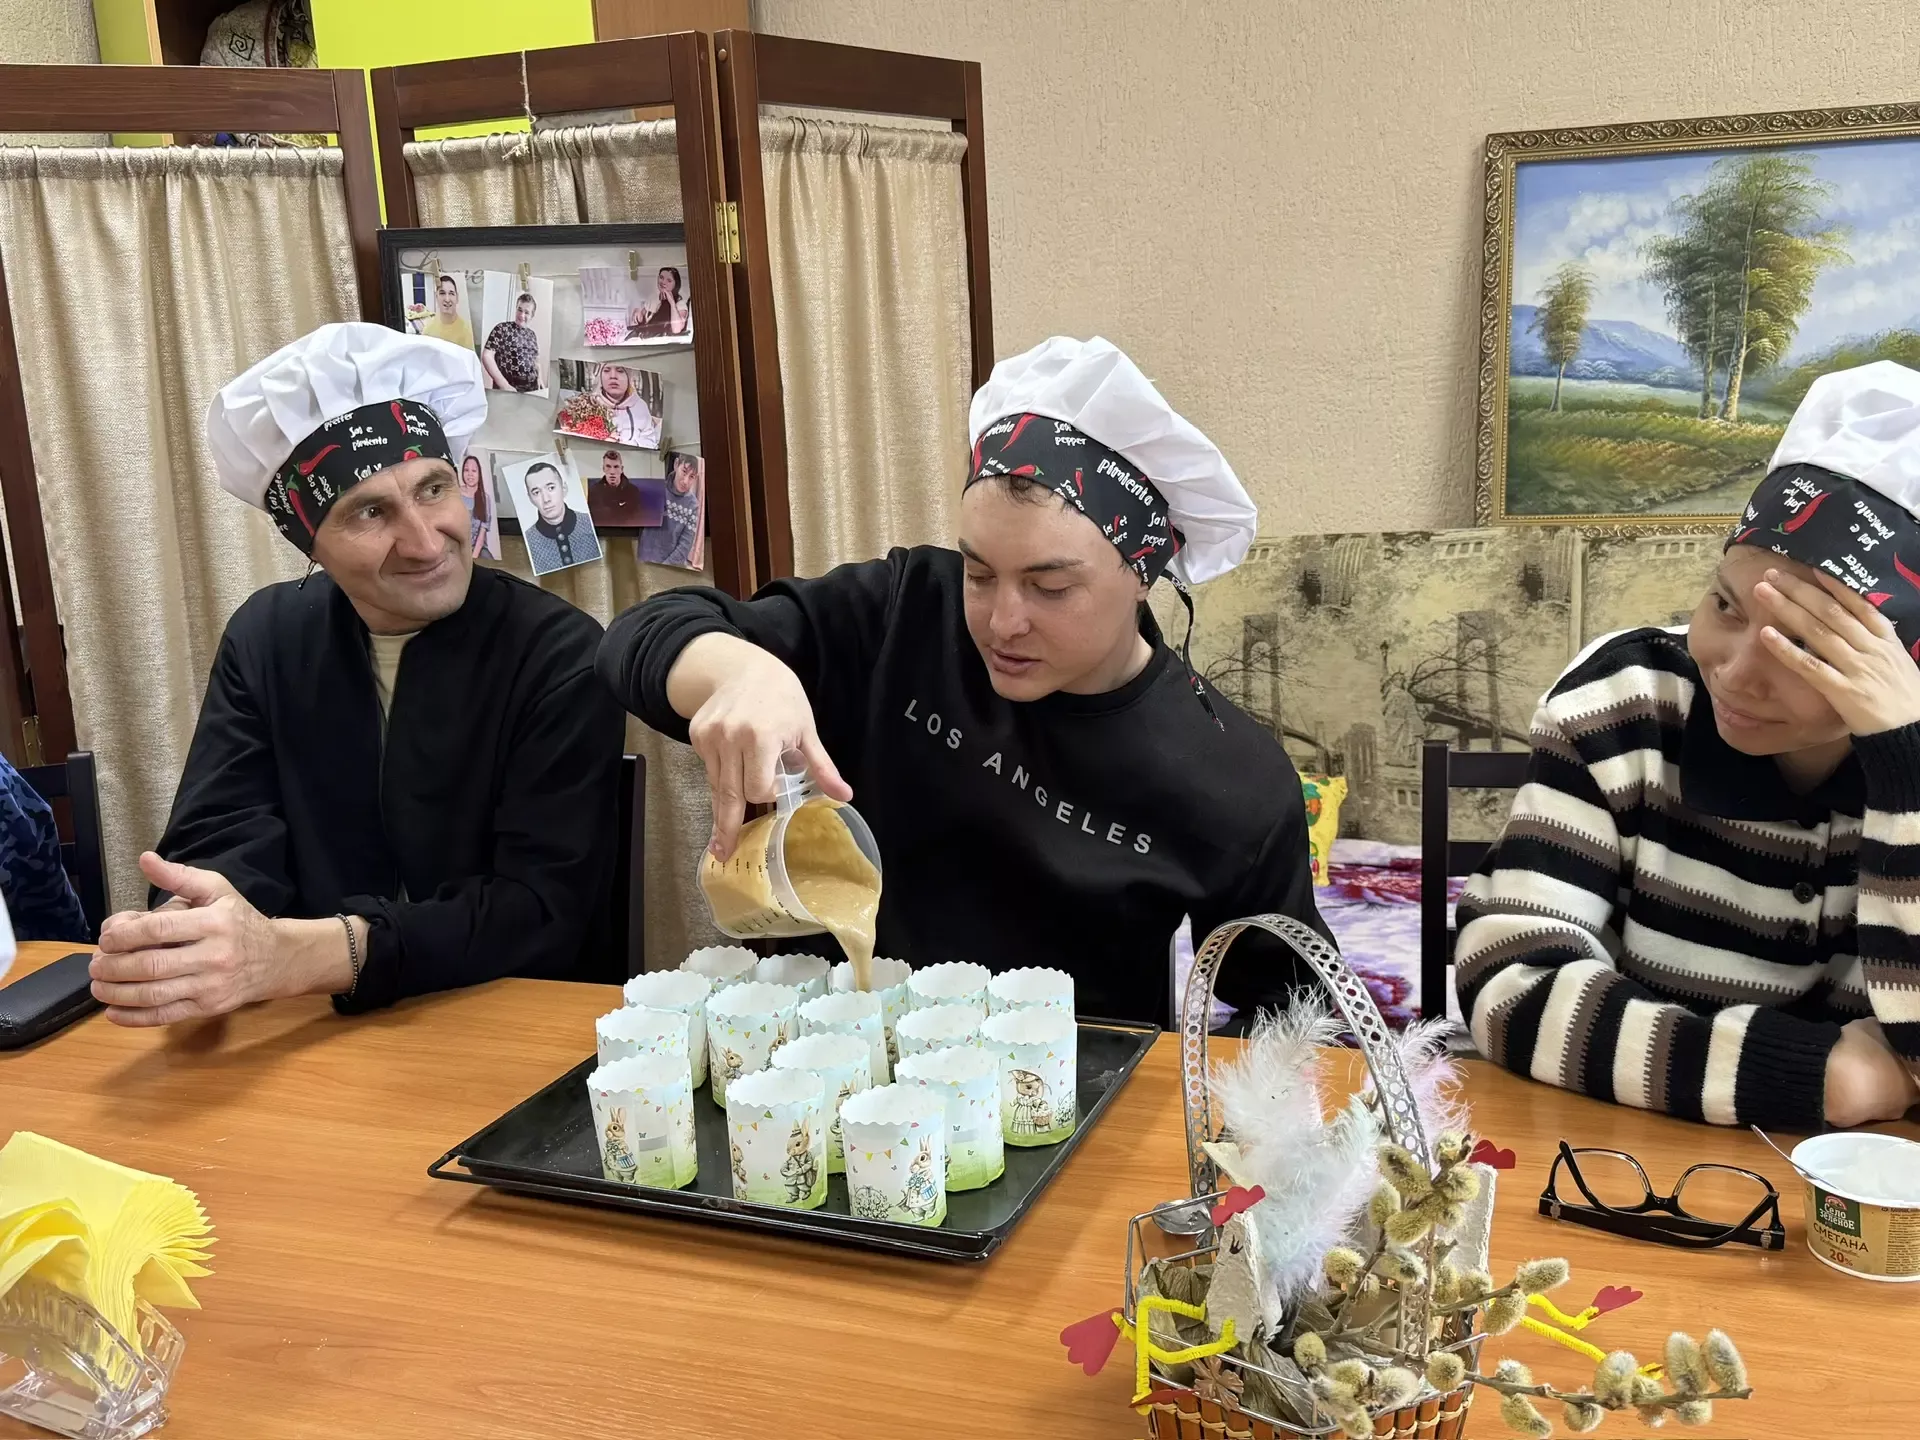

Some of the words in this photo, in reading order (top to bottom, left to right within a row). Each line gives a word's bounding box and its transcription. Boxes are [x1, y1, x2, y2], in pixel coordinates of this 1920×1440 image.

[904, 699, 962, 750] LOS
[982, 751, 1152, 855] ANGELES
[1813, 1222, 1869, 1253] СМЕТАНА
[1829, 1248, 1854, 1267] 20%
